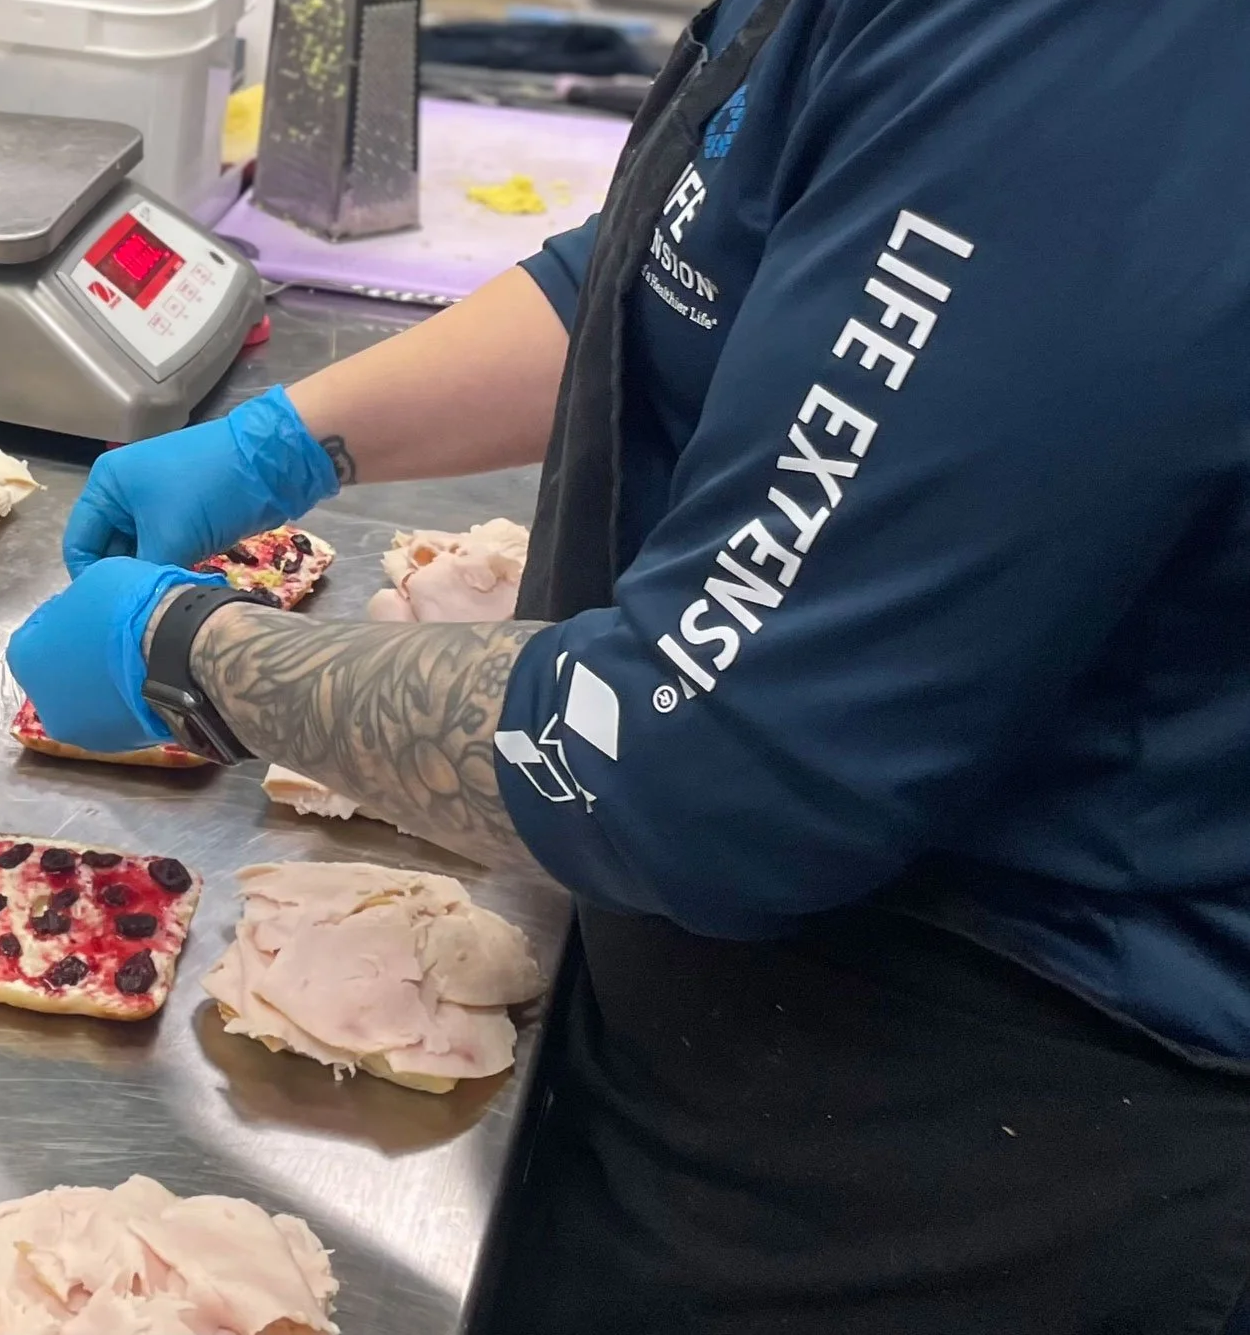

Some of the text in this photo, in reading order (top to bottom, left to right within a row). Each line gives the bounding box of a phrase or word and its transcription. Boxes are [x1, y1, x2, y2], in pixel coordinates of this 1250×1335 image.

[662, 162, 707, 244] IFE
[650, 227, 719, 302] NSION
[650, 271, 690, 317] Healthier
[832, 209, 975, 391] LIFE
